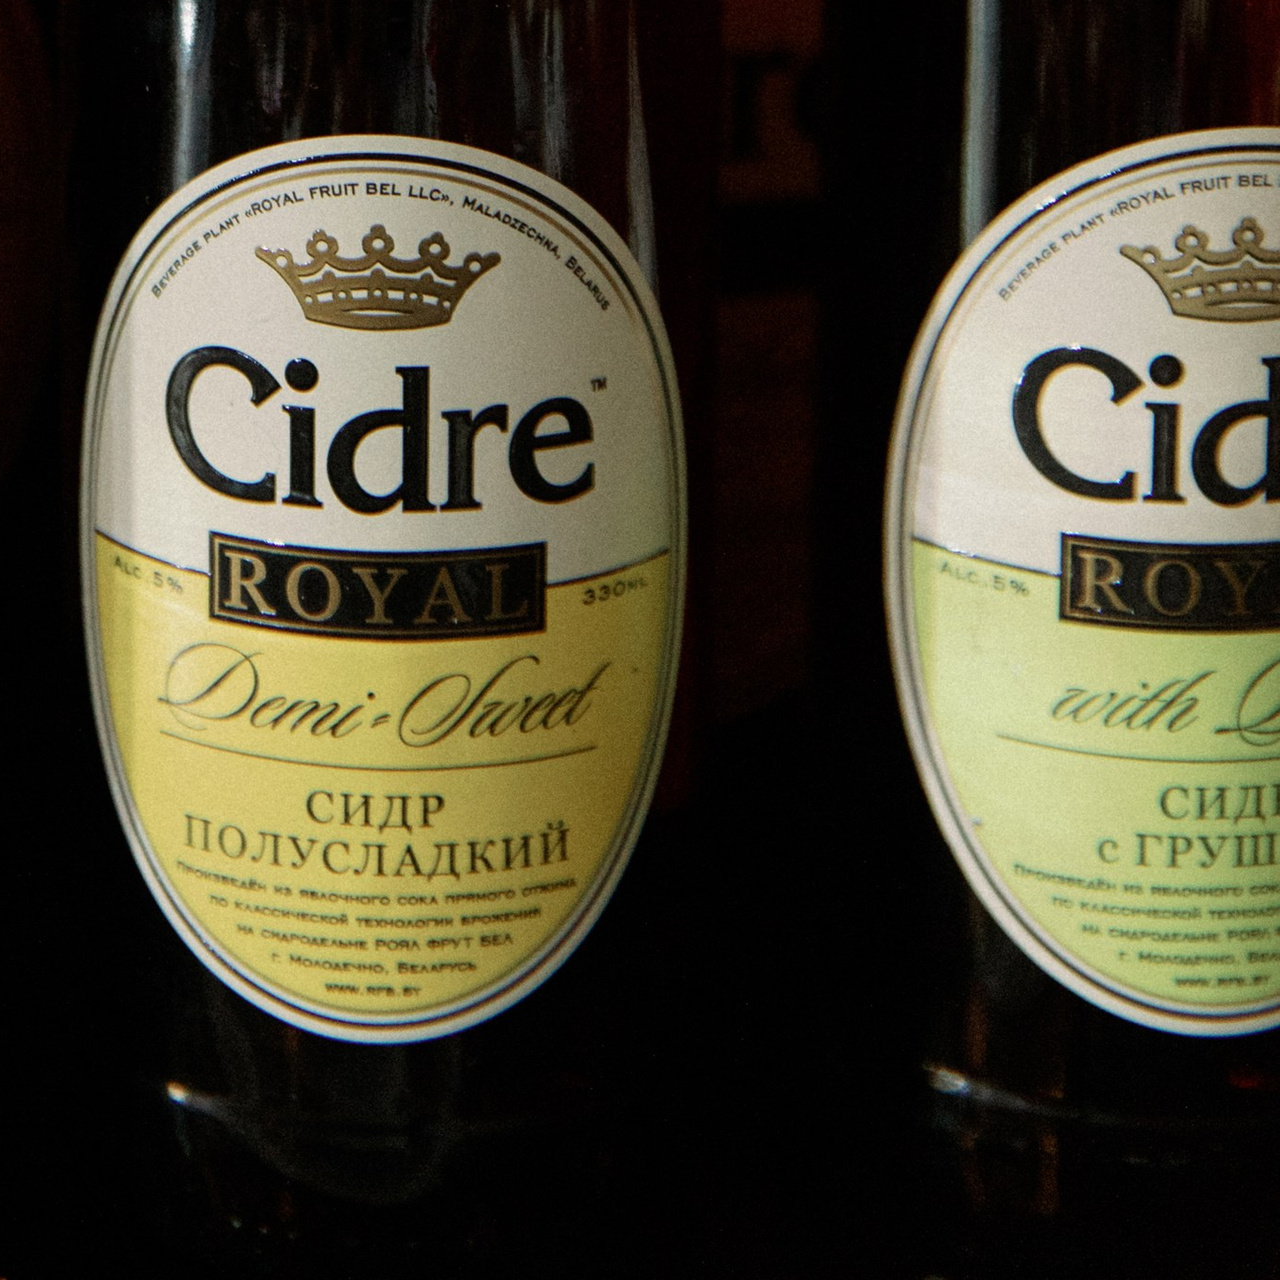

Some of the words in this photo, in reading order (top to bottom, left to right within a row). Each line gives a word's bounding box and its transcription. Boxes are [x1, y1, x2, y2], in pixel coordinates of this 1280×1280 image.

[150, 242, 201, 300] BEVERAGE
[202, 213, 241, 244] PLANT
[308, 182, 360, 201] FRUIT
[365, 182, 402, 197] BEL
[462, 195, 561, 261] MALADZECHNA,
[565, 255, 611, 312] BELARUS
[998, 244, 1062, 303] BEVERAGE
[1061, 213, 1106, 245] PLANT
[1179, 175, 1232, 196] FRUIT
[1237, 174, 1273, 188] BEL
[165, 345, 596, 516] Cidre
[1012, 346, 1280, 508] Cid
[224, 547, 529, 627] ROYAL
[992, 574, 1030, 597] 5%
[1076, 550, 1280, 618] ROY
[158, 641, 611, 748] Demi-Sweet
[1051, 668, 1217, 734] with
[306, 790, 447, 833] СИДР
[183, 813, 570, 882] ПОЛУСЛАДКИЙ
[234, 900, 349, 925] КЛАССИЧЕСКОЙ
[397, 895, 438, 906] СОКА
[375, 938, 421, 951] РОЯЛ
[426, 937, 474, 950] ФРУТ
[479, 932, 514, 949] БЕЛ
[397, 960, 478, 975] БЕЛАРУСЬ
